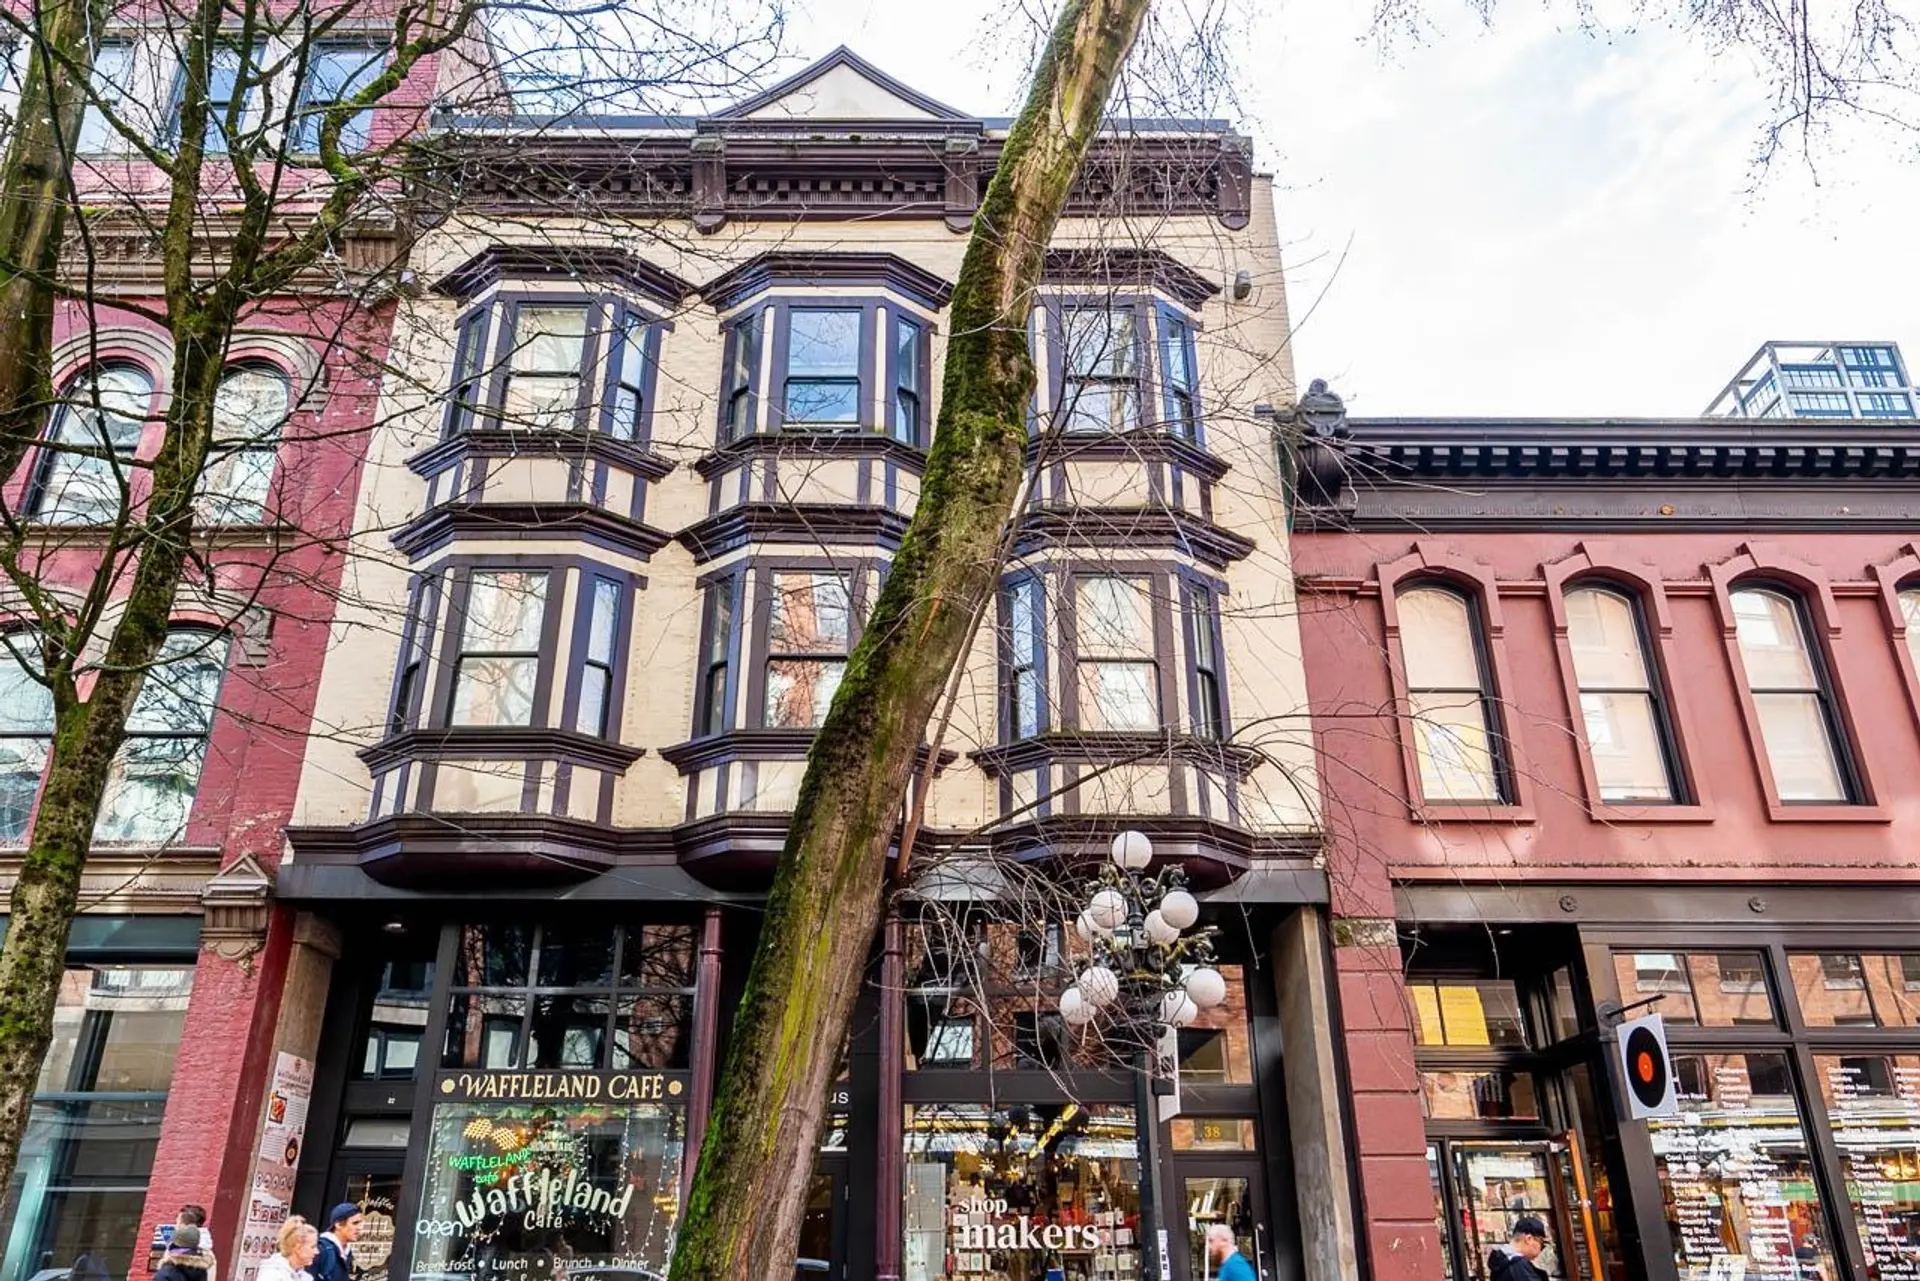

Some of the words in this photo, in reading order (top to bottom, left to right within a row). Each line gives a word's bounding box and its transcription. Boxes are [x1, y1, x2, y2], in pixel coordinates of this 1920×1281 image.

[459, 1073, 601, 1099] WAFFLELAND
[608, 1073, 663, 1099] CAFÉ
[1204, 1126, 1221, 1138] 38
[448, 1147, 532, 1170] WAFFLELAND
[455, 1168, 635, 1228] Waffleland
[959, 1196, 1008, 1220] shop
[417, 1219, 463, 1238] open
[523, 1209, 564, 1231] Café
[1679, 1218, 1706, 1227] Country
[1707, 1217, 1723, 1226] Pop
[962, 1216, 1100, 1249] makers
[1680, 1227, 1693, 1236] Big
[492, 1258, 528, 1270] Lunch
[553, 1257, 592, 1270] Brunch
[612, 1257, 650, 1270] Dinner
